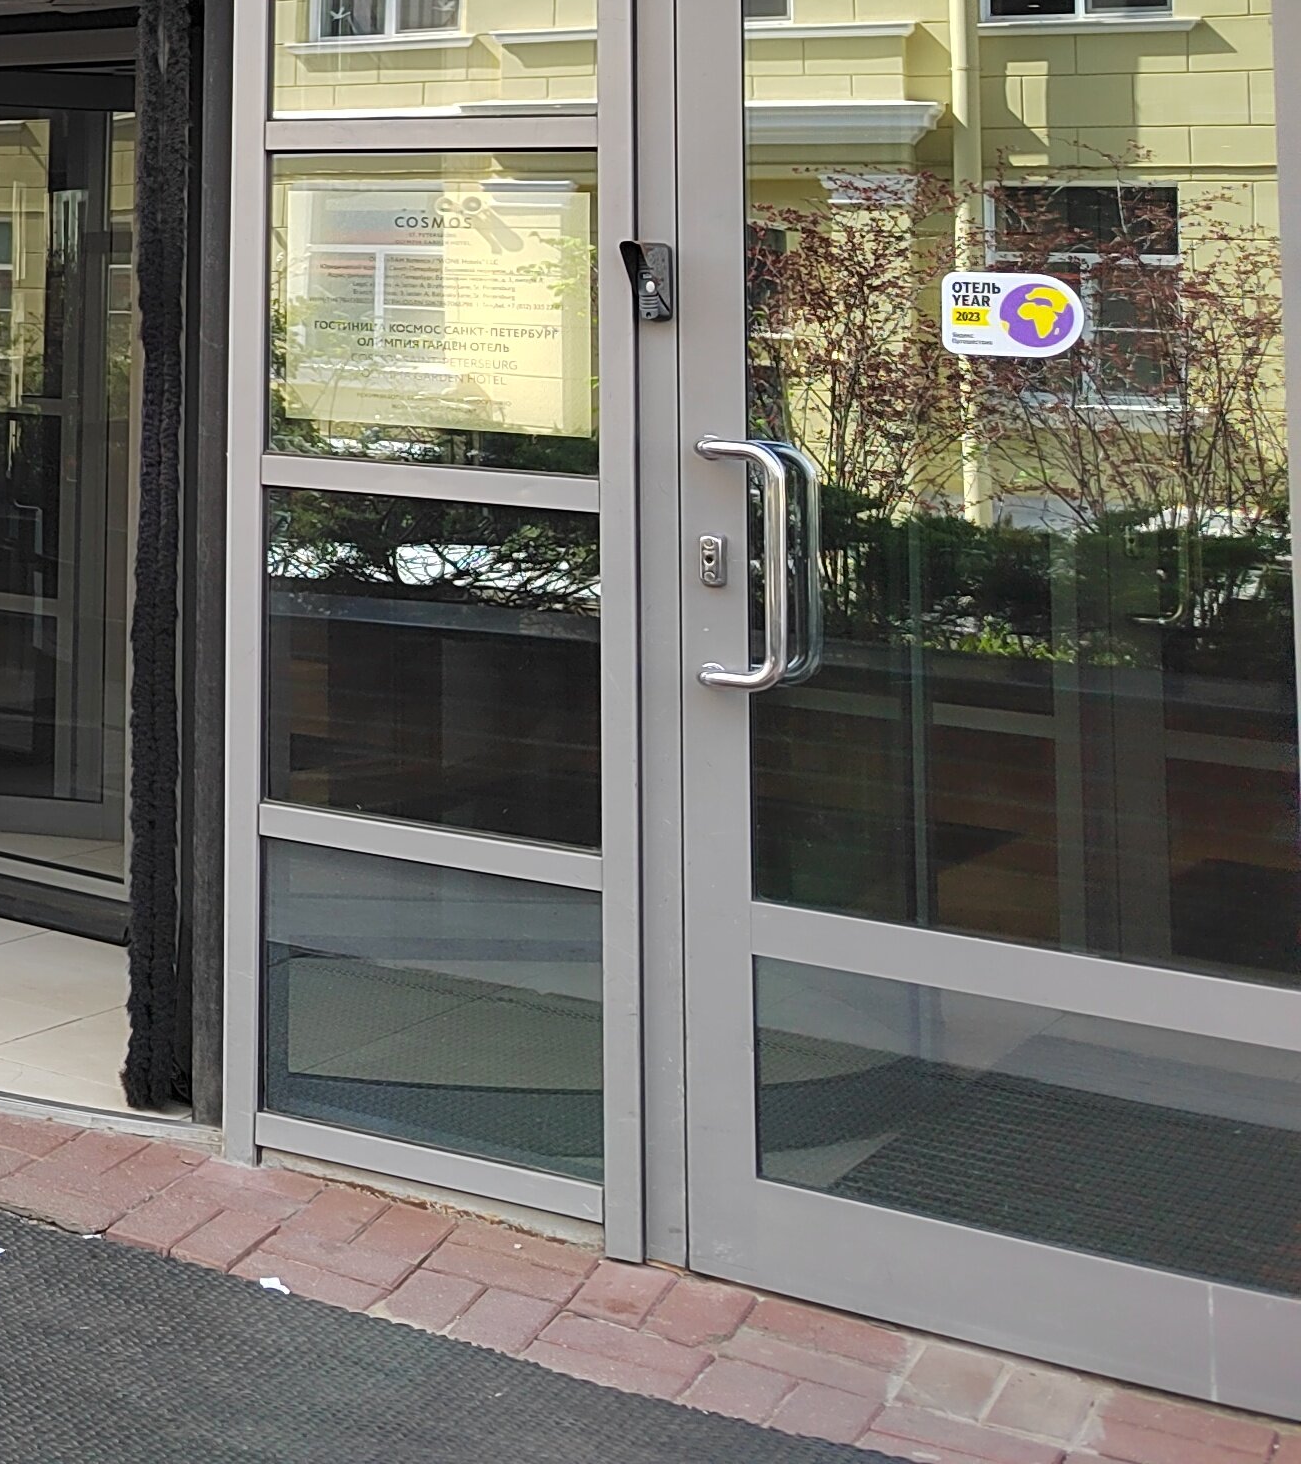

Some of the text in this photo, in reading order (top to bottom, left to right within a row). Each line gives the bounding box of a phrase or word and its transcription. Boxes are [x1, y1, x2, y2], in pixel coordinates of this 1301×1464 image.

[394, 216, 472, 229] COSMOS
[952, 281, 1001, 294] ОТЕЛЬ
[952, 294, 991, 307] YEAR
[956, 311, 981, 322] 2023
[389, 323, 441, 334] КОСМОС
[470, 342, 510, 353] ОТЕЛЬ
[467, 374, 508, 385] HOTEL
